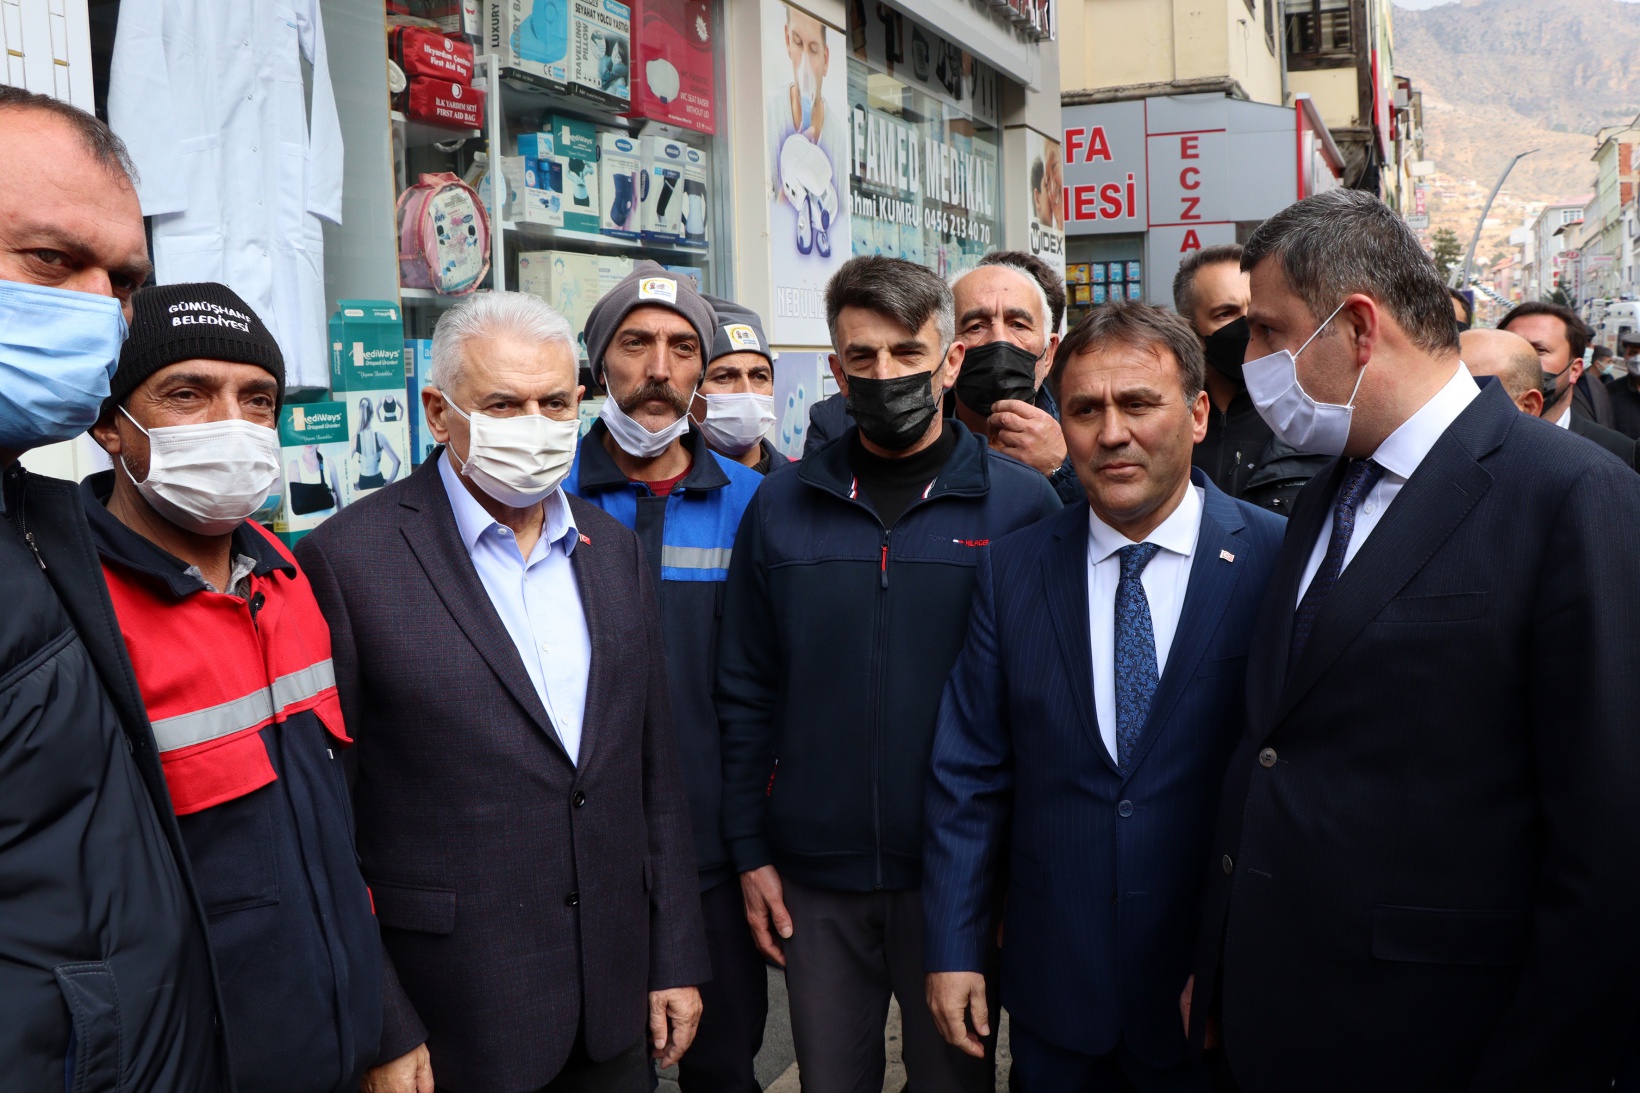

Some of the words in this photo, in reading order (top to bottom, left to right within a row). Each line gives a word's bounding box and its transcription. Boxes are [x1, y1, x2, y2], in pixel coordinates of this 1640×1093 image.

[492, 3, 500, 48] LUXURY
[575, 3, 597, 20] SEYAHAT
[597, 12, 612, 26] YOLCU
[513, 15, 521, 67] LUXURY
[430, 57, 444, 67] First
[445, 61, 456, 71] Aid
[457, 64, 467, 77] Bag
[436, 107, 453, 118] FIRST
[453, 111, 464, 120] AID
[464, 113, 476, 121] BAG
[879, 196, 920, 228] KUMRU
[924, 207, 948, 234] 0456
[950, 213, 966, 239] 213
[968, 220, 979, 241] 40
[980, 223, 991, 245] 70
[1031, 221, 1063, 256] WIDEX
[169, 301, 251, 323] GÜMÜŞHANE
[172, 314, 250, 334] BELEDİYESİ
